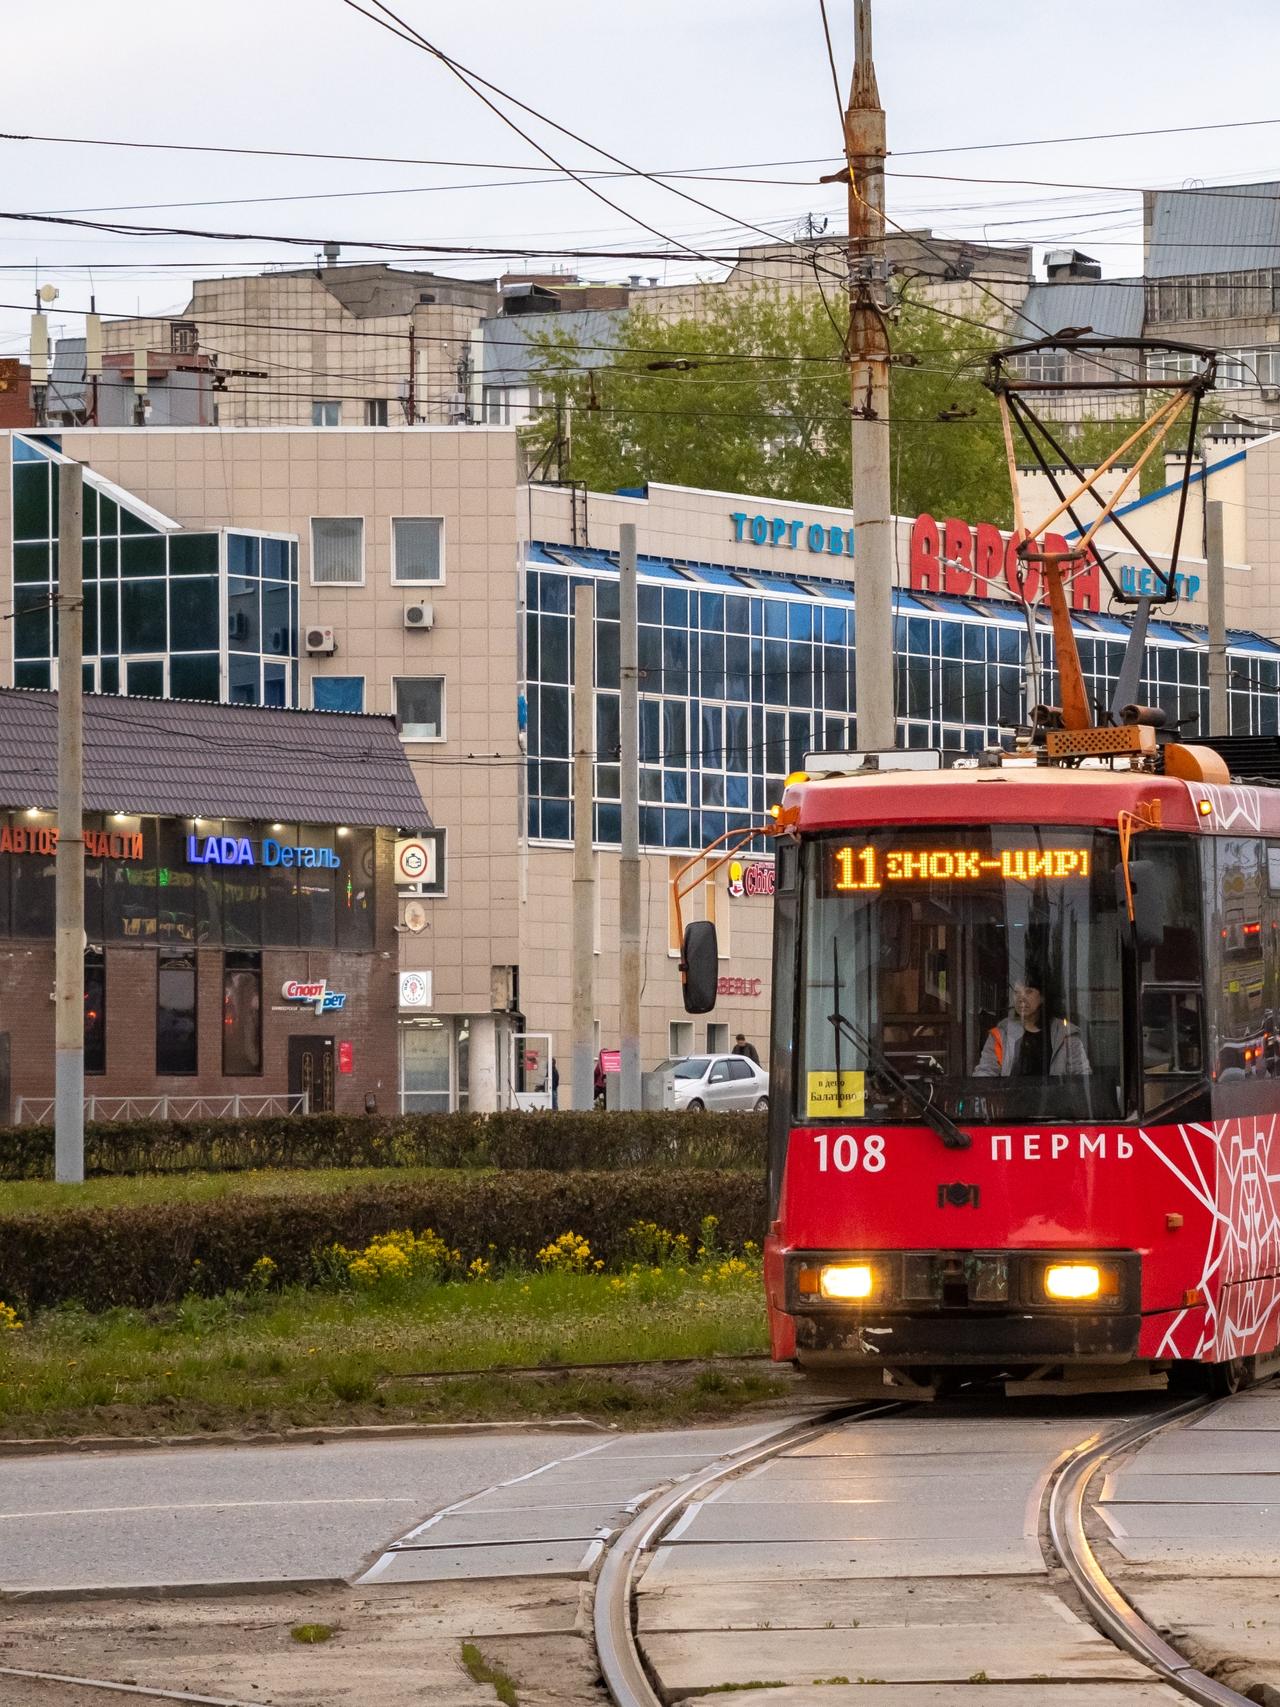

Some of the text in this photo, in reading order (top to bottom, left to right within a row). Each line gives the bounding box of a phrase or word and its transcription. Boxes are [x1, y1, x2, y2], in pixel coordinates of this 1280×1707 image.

[0, 824, 144, 861] АВТОЗЧАСТИ
[186, 834, 254, 866] LADA
[836, 846, 881, 889] 11
[287, 982, 324, 997] Спорт
[813, 1133, 886, 1173] 108
[991, 1133, 1134, 1161] ПЕРМЬ
